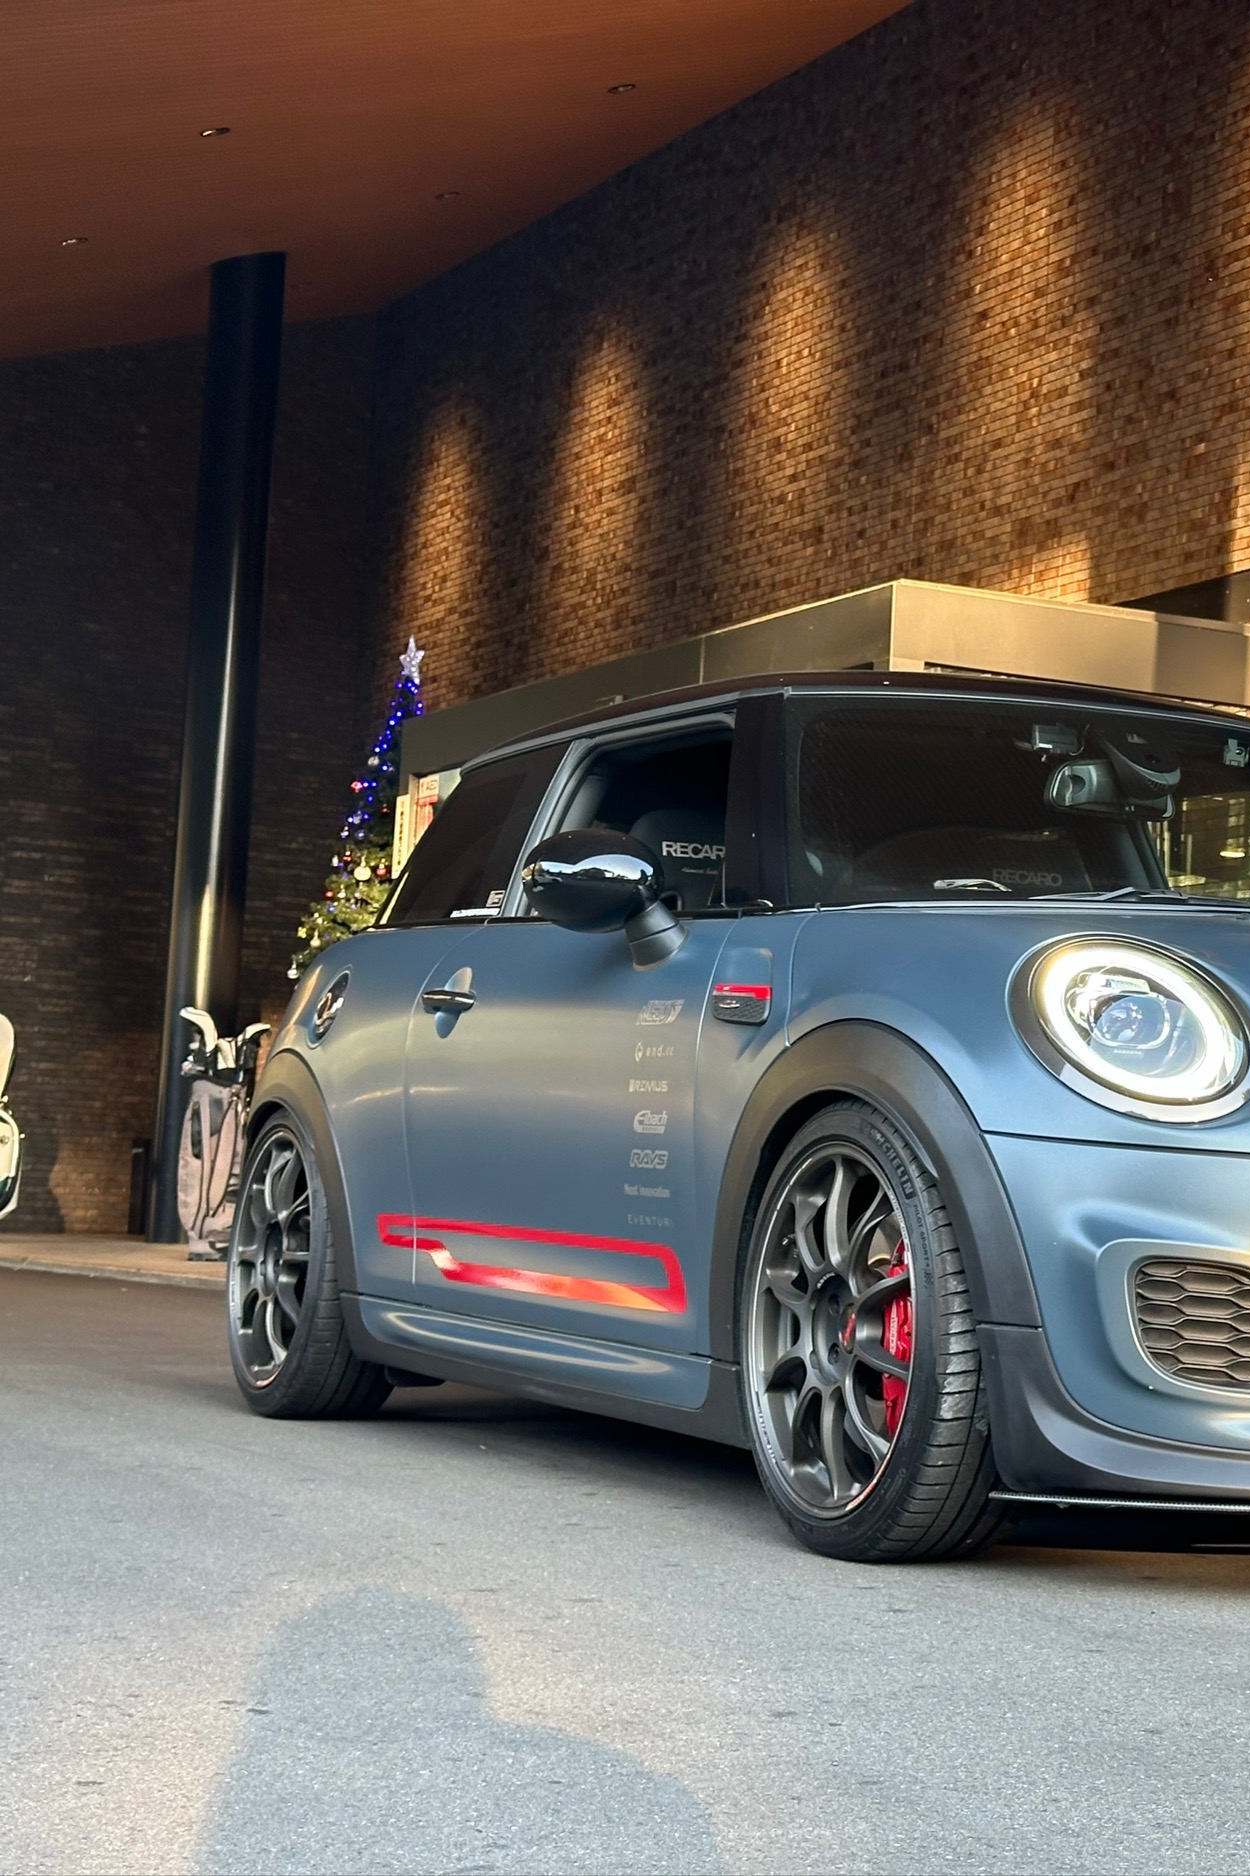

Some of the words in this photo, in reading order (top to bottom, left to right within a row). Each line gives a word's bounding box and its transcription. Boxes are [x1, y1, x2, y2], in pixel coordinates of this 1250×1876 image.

[992, 868, 1063, 887] RECARO
[634, 1110, 668, 1133] Eibach
[630, 1149, 668, 1169] RAYS
[869, 1128, 914, 1195] MICHELIN
[912, 1204, 924, 1228] PILOT
[919, 1231, 931, 1261] SPORT
